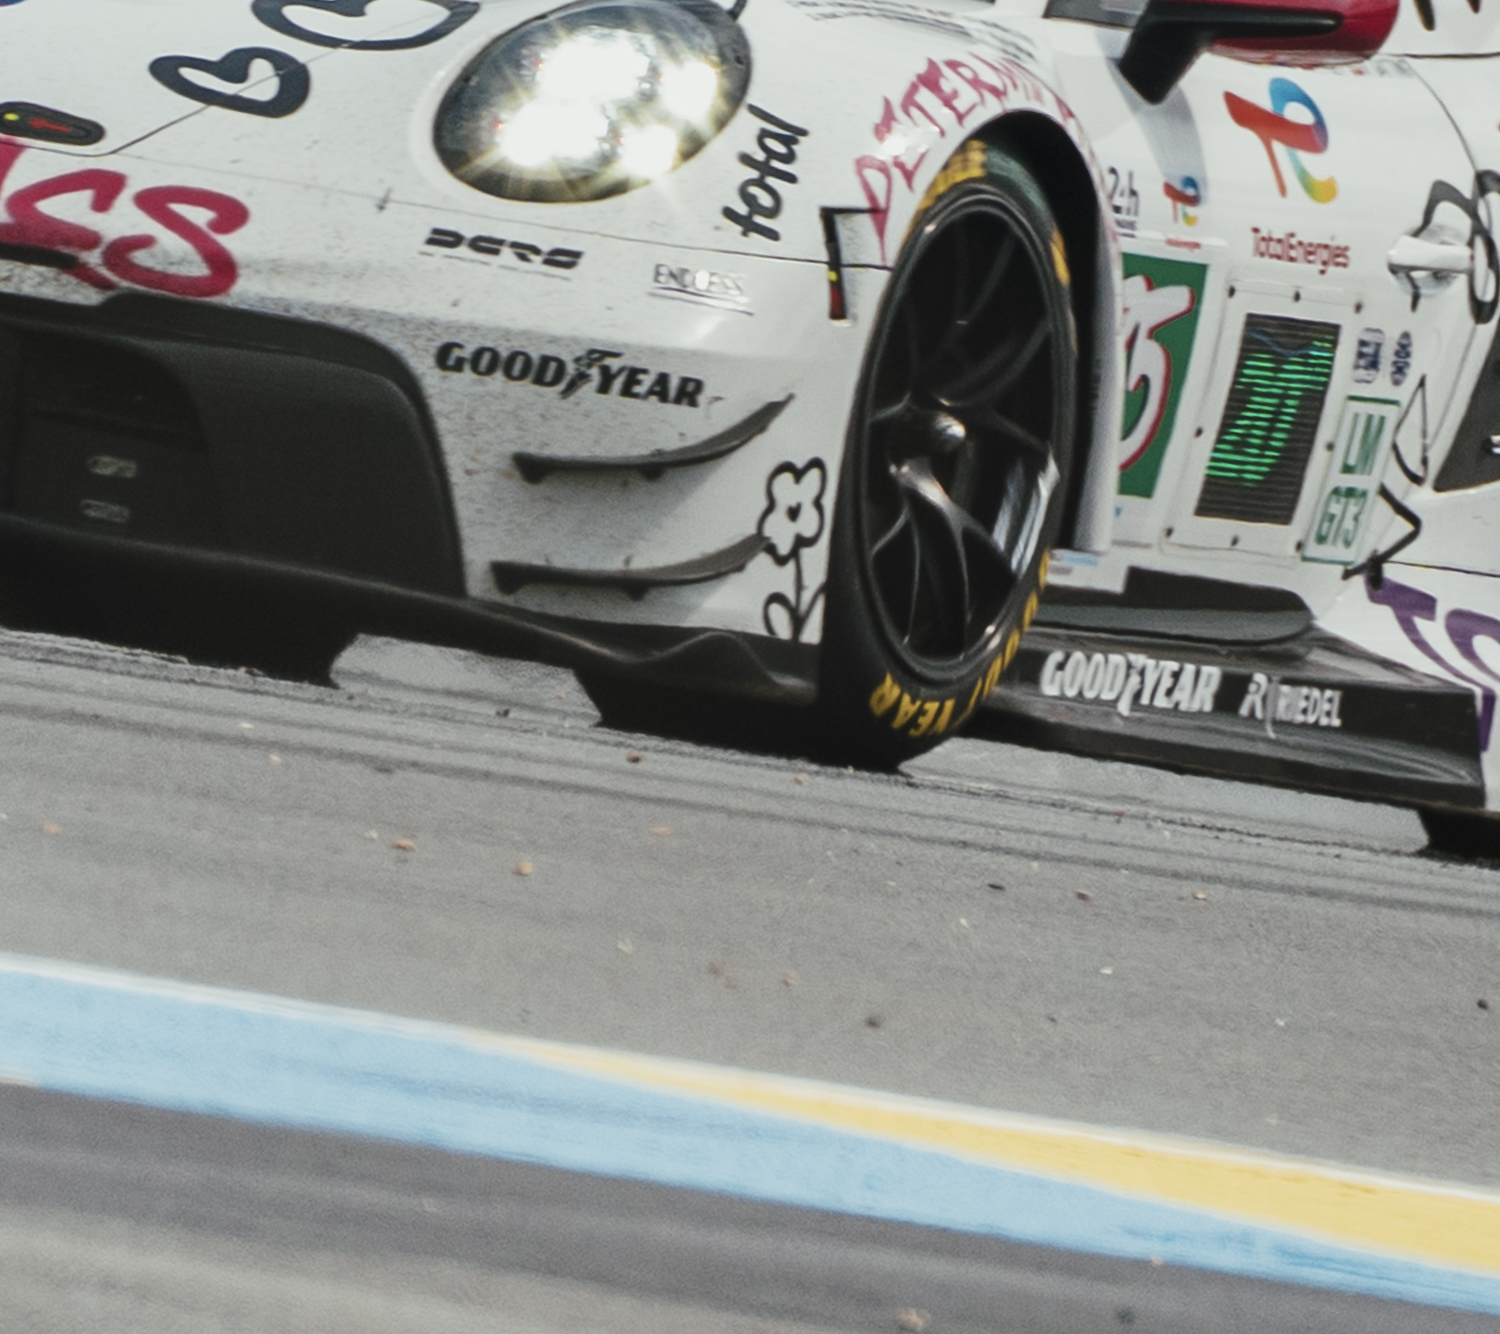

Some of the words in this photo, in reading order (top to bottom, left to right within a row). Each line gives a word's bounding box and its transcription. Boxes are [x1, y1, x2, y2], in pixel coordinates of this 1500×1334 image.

[721, 101, 811, 243] total
[1250, 226, 1351, 276] TotalEnergies
[434, 340, 706, 409] GOODYEAR
[1339, 411, 1387, 477] LM
[1039, 649, 1223, 717] GOODYEAR
